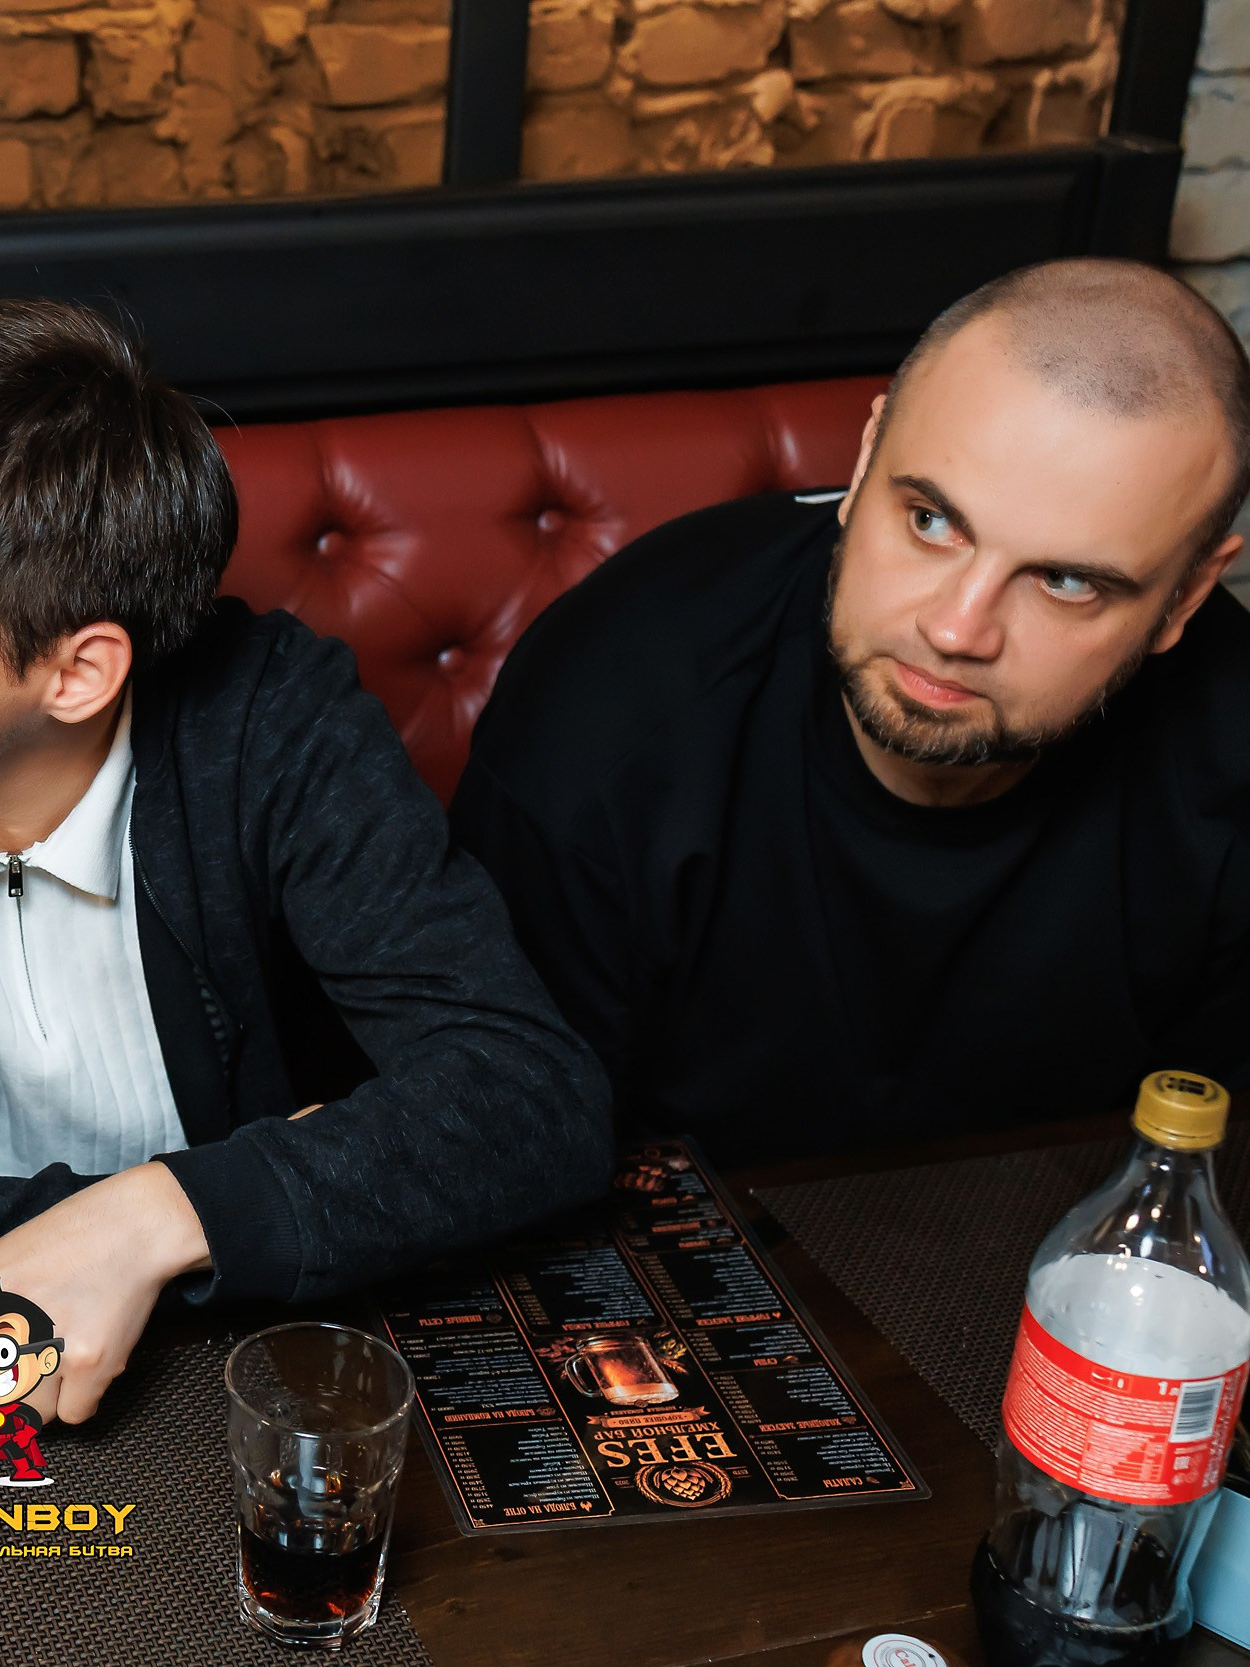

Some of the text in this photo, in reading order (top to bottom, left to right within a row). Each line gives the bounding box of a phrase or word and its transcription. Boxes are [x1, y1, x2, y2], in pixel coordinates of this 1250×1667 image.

[418, 1315, 482, 1326] ПИВНЫЕ СЕТЫ
[444, 1412, 491, 1422] КОМПАНИЮ
[644, 1414, 682, 1423] ХОРОШЕЕ
[593, 1422, 720, 1440] ХМЕЛЬНОЙ БАР
[758, 1418, 841, 1432] ХОЛОДНЫЕ ЗАКУСКИ
[597, 1432, 737, 1468] EFES
[823, 1476, 863, 1488] САЛАТЫ
[503, 1502, 576, 1516] БЛЮДА НА ОГНЕ
